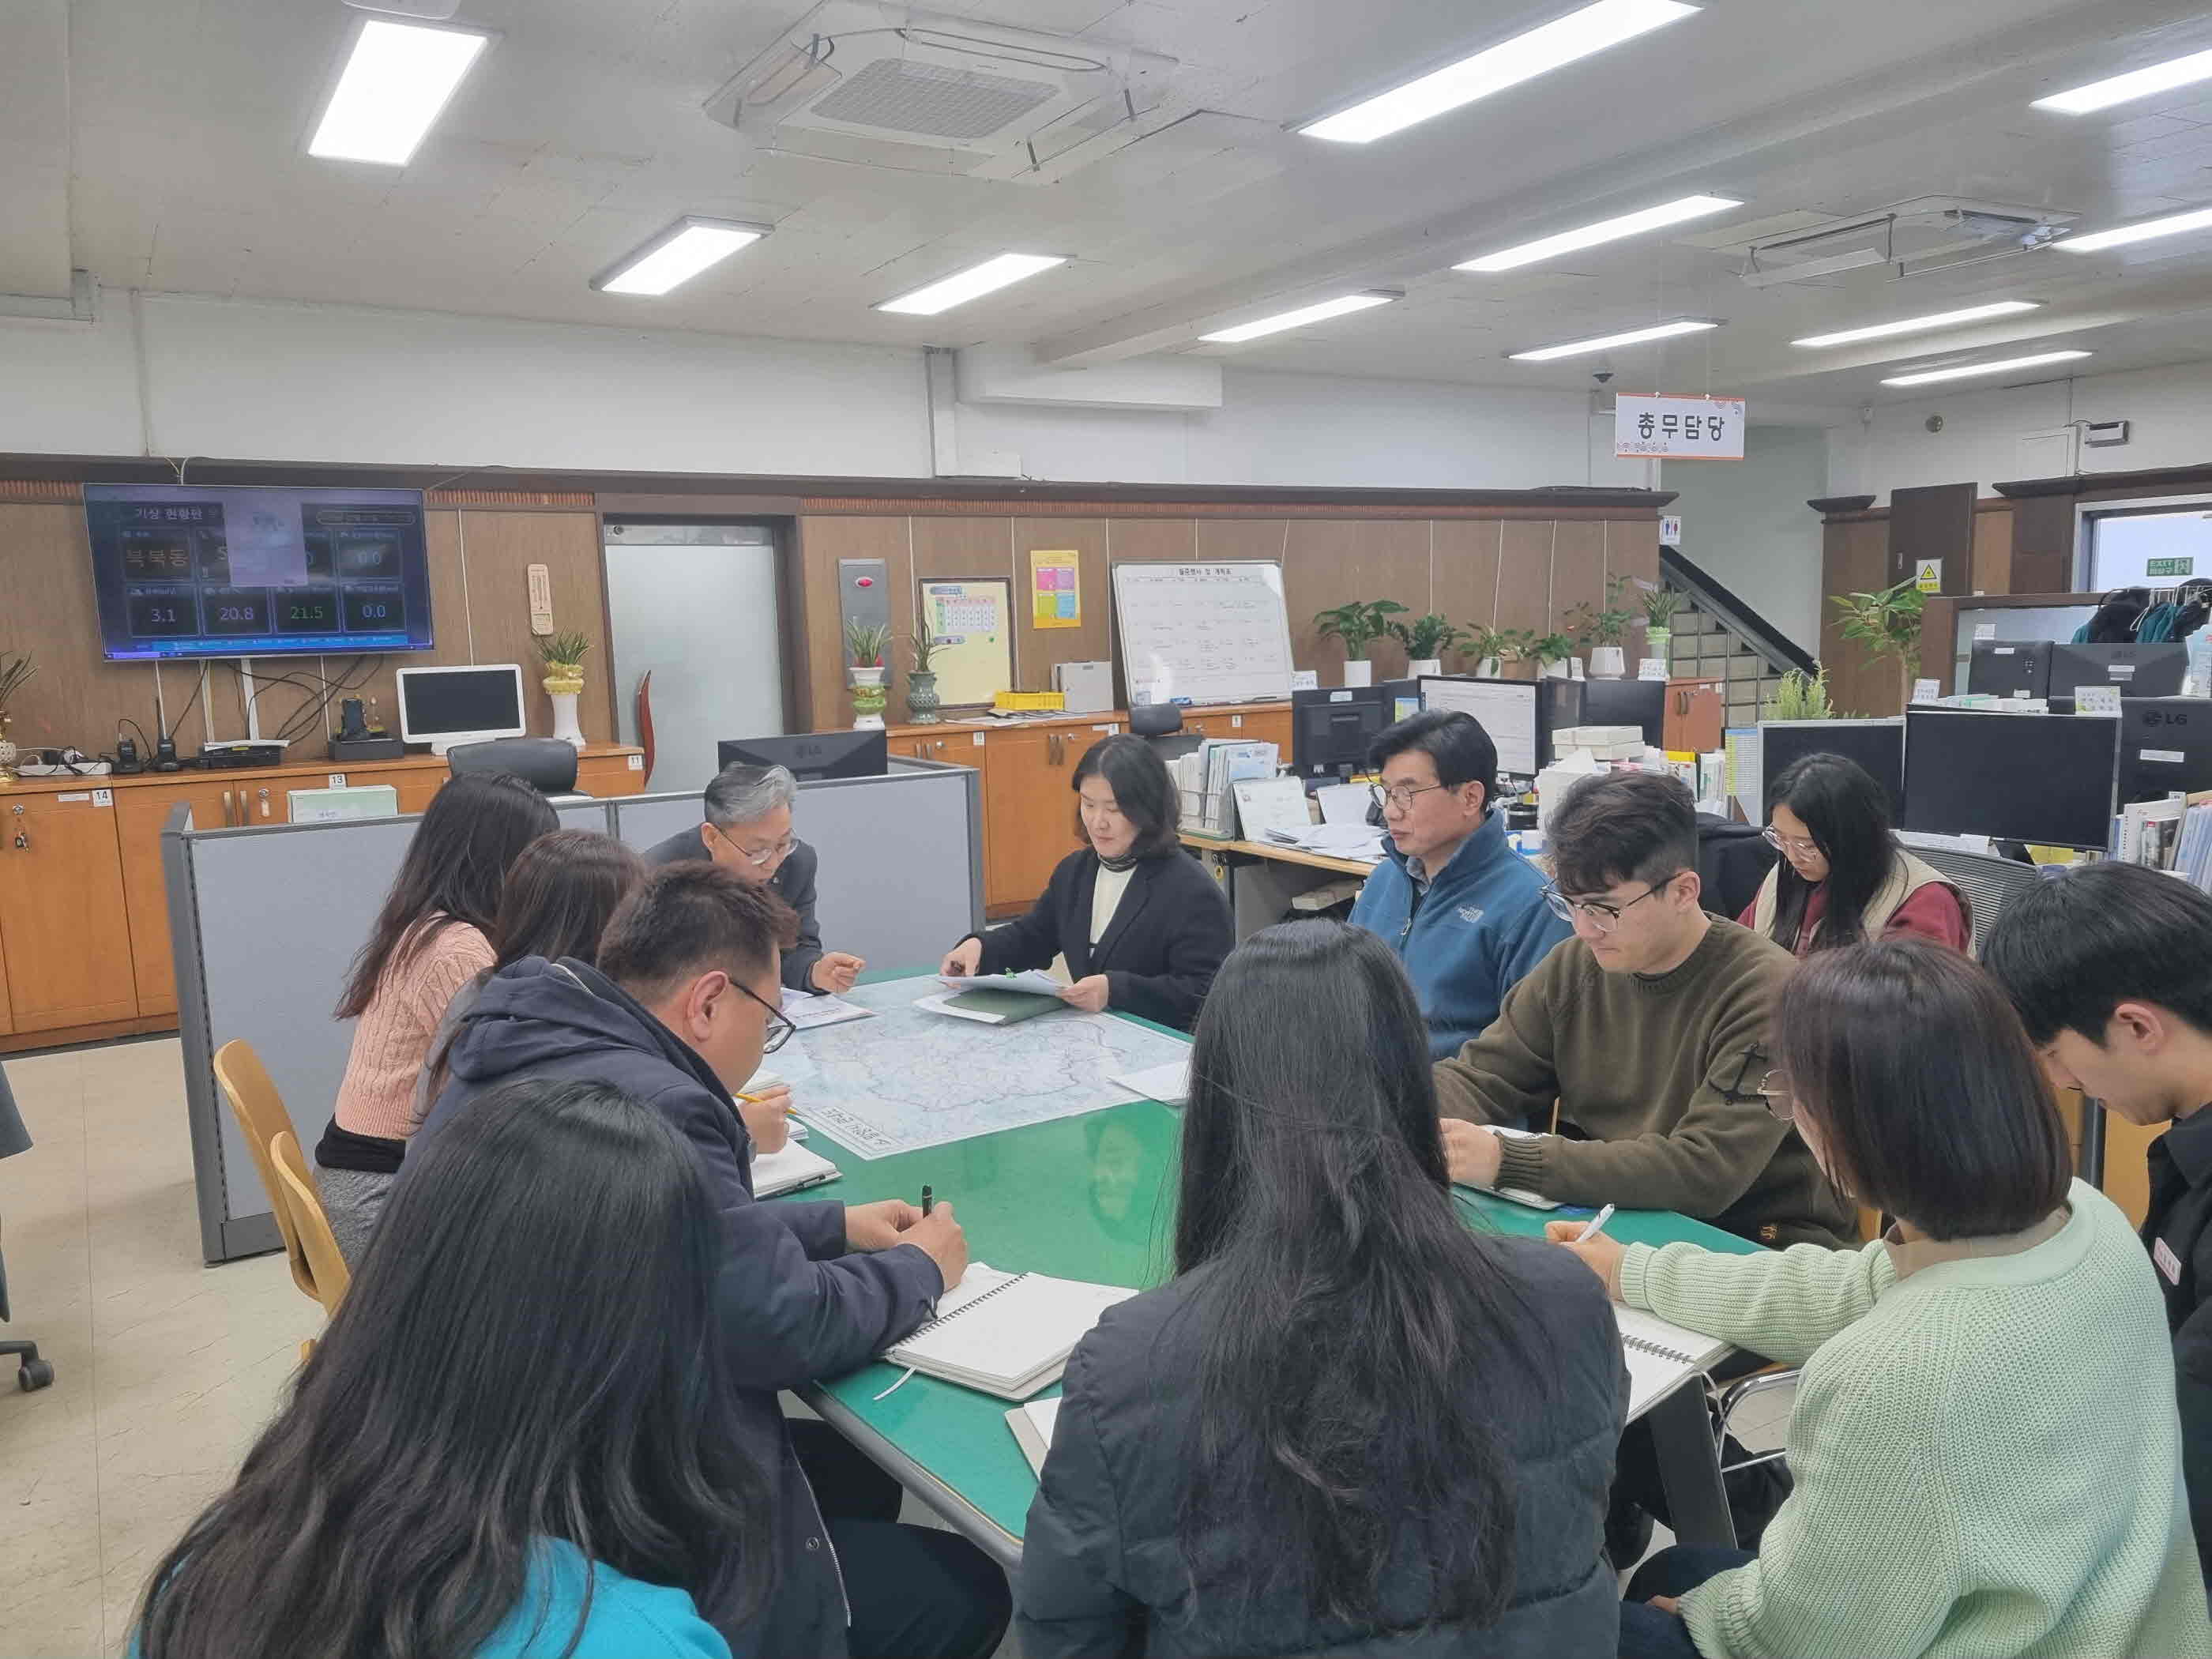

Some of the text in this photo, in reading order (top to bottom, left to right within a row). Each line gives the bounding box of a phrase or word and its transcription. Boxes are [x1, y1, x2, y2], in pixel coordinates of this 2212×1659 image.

[1638, 412, 1725, 441] 총무담당
[134, 506, 159, 520] 기상
[150, 608, 176, 623] 3.1
[220, 607, 254, 620] 20.8
[290, 606, 323, 619] 21.5
[363, 604, 386, 619] 0.0
[2167, 713, 2188, 725] LG
[333, 775, 343, 784] 13
[96, 790, 108, 799] 14
